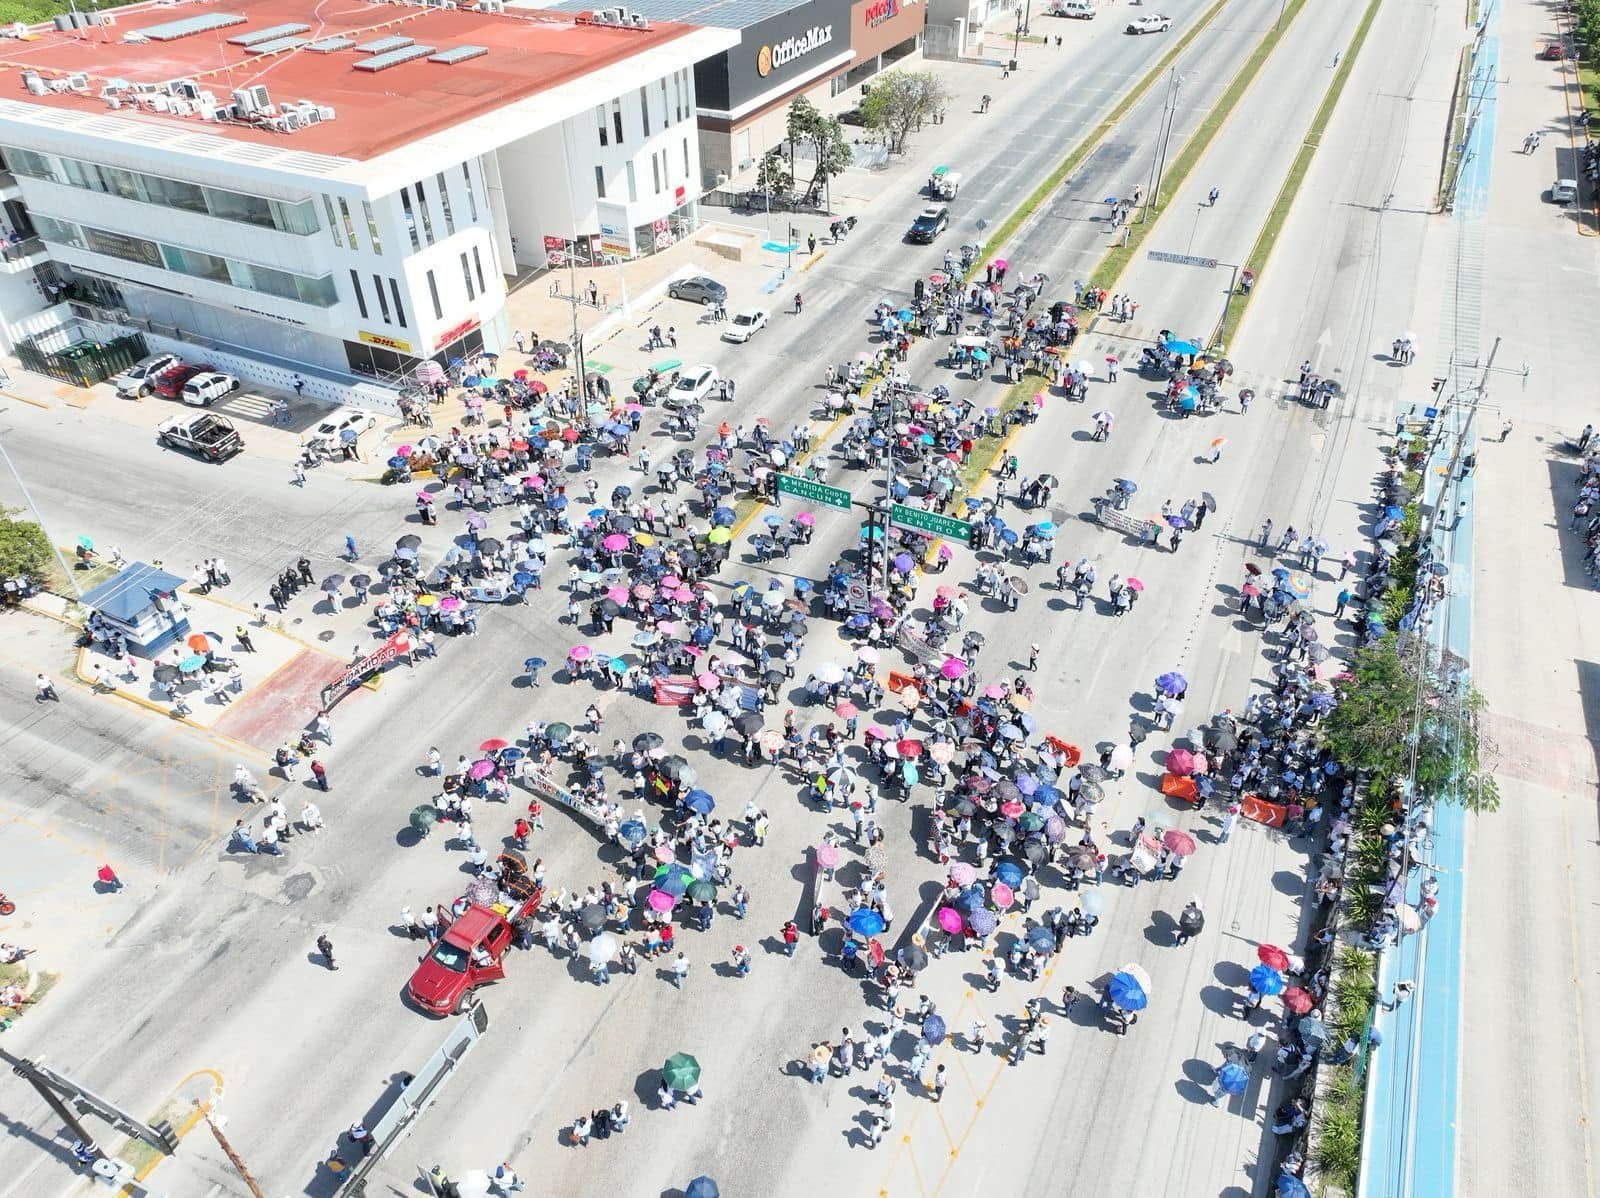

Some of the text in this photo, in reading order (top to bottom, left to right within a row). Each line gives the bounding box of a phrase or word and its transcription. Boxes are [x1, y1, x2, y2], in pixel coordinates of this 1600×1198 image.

[772, 24, 832, 68] OfficeMax
[784, 485, 832, 503] CANCUN
[791, 480, 823, 493] MERIDA
[897, 515, 953, 535] CENTRO
[905, 510, 928, 521] BENITO
[931, 517, 956, 528] JUAREZ
